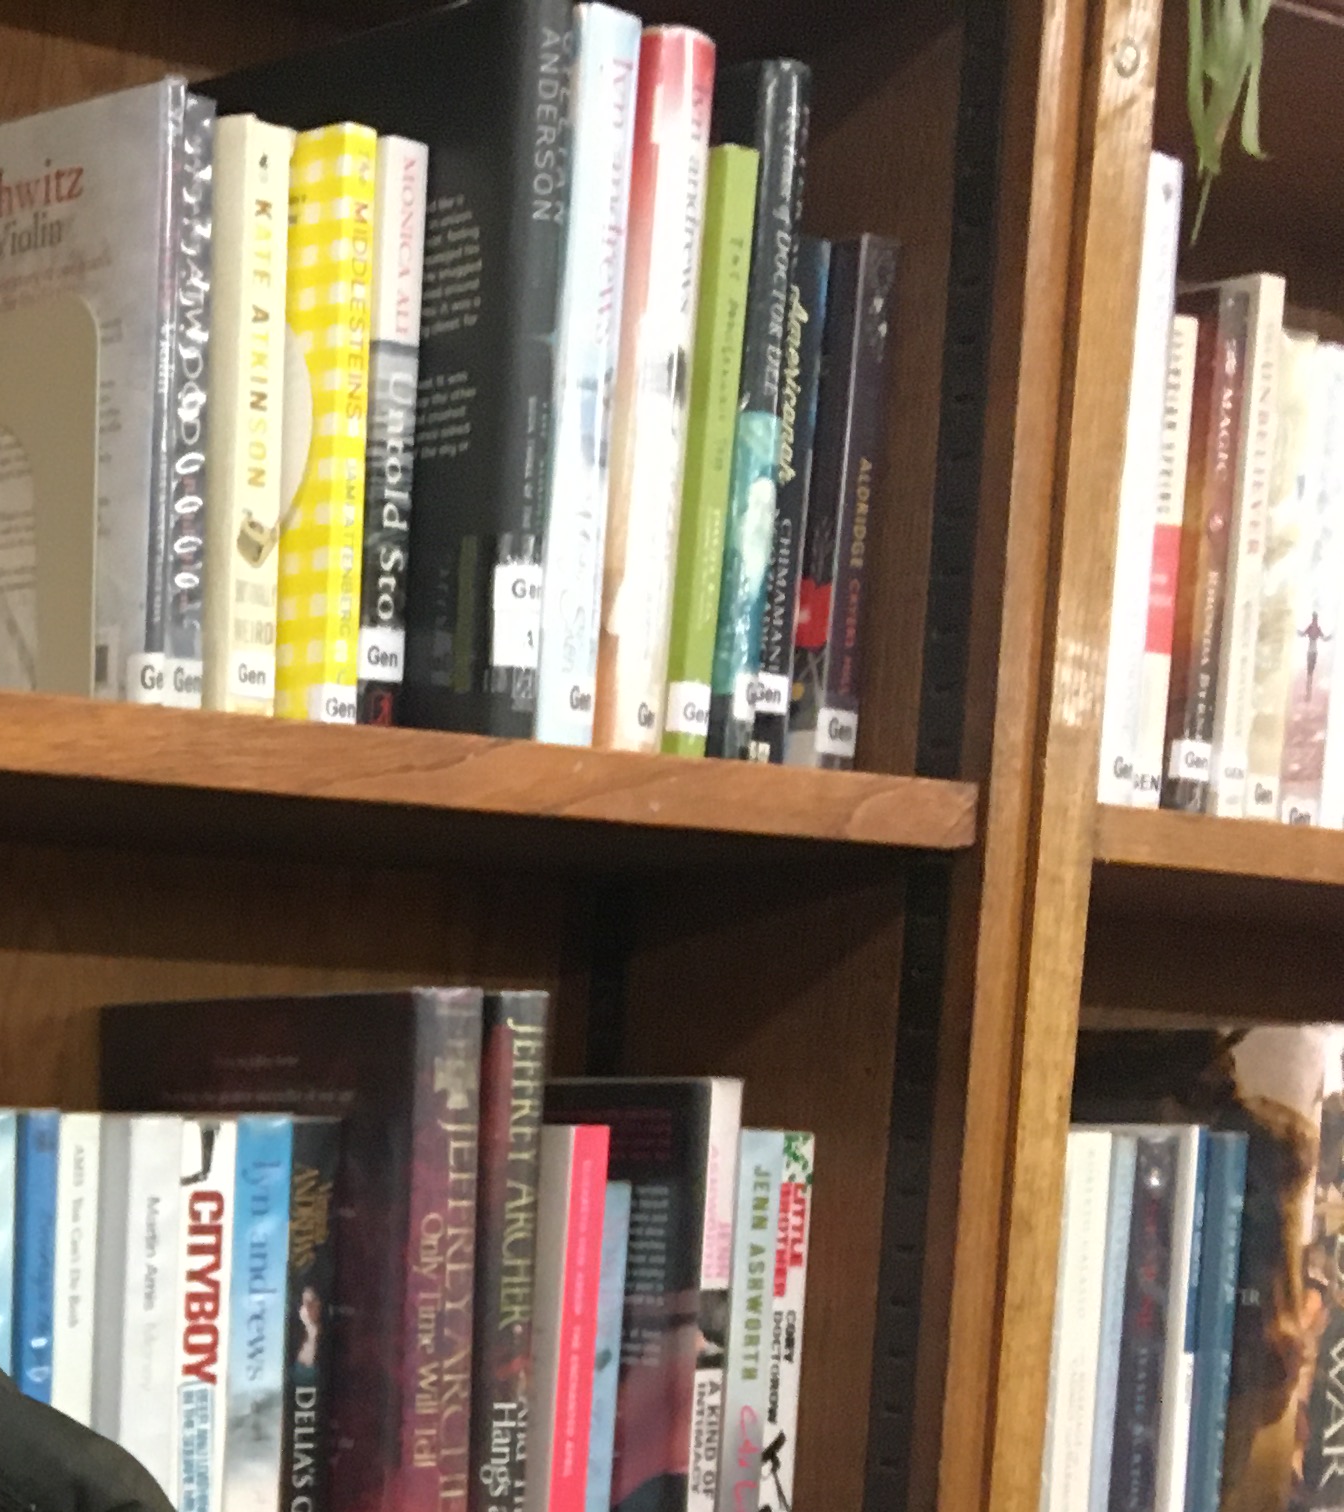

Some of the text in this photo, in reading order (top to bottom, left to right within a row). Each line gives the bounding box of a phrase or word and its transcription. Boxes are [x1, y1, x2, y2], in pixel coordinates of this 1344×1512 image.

[531, 28, 559, 222] ANDERSON
[344, 200, 370, 420] MIDDLESTEINS
[394, 156, 418, 336] MONICA ALI
[246, 198, 273, 489] KATE ATKINSON
[777, 283, 810, 486] Americanah
[382, 370, 414, 530] Untold
[849, 458, 872, 568] ALDRIDGE
[238, 663, 267, 686] Gen
[325, 697, 356, 720] Gen
[367, 645, 399, 668] Gen
[143, 1195, 162, 1312] Martin Amis
[438, 1120, 478, 1328] JEFFREY
[497, 1021, 547, 1330] JEFFREY ARCHER
[181, 1190, 226, 1387] CITYBOY
[241, 1159, 281, 1383] lyn andrews
[412, 1212, 443, 1415] Only Time Will
[741, 1165, 771, 1381] JENN ASHWORTH
[783, 1310, 798, 1364] CORY
[291, 1386, 318, 1488] DELIA'S
[480, 1399, 518, 1496] Hangs
[701, 1380, 720, 1499] A KIND OF
[766, 1309, 784, 1425] DOCTOROW
